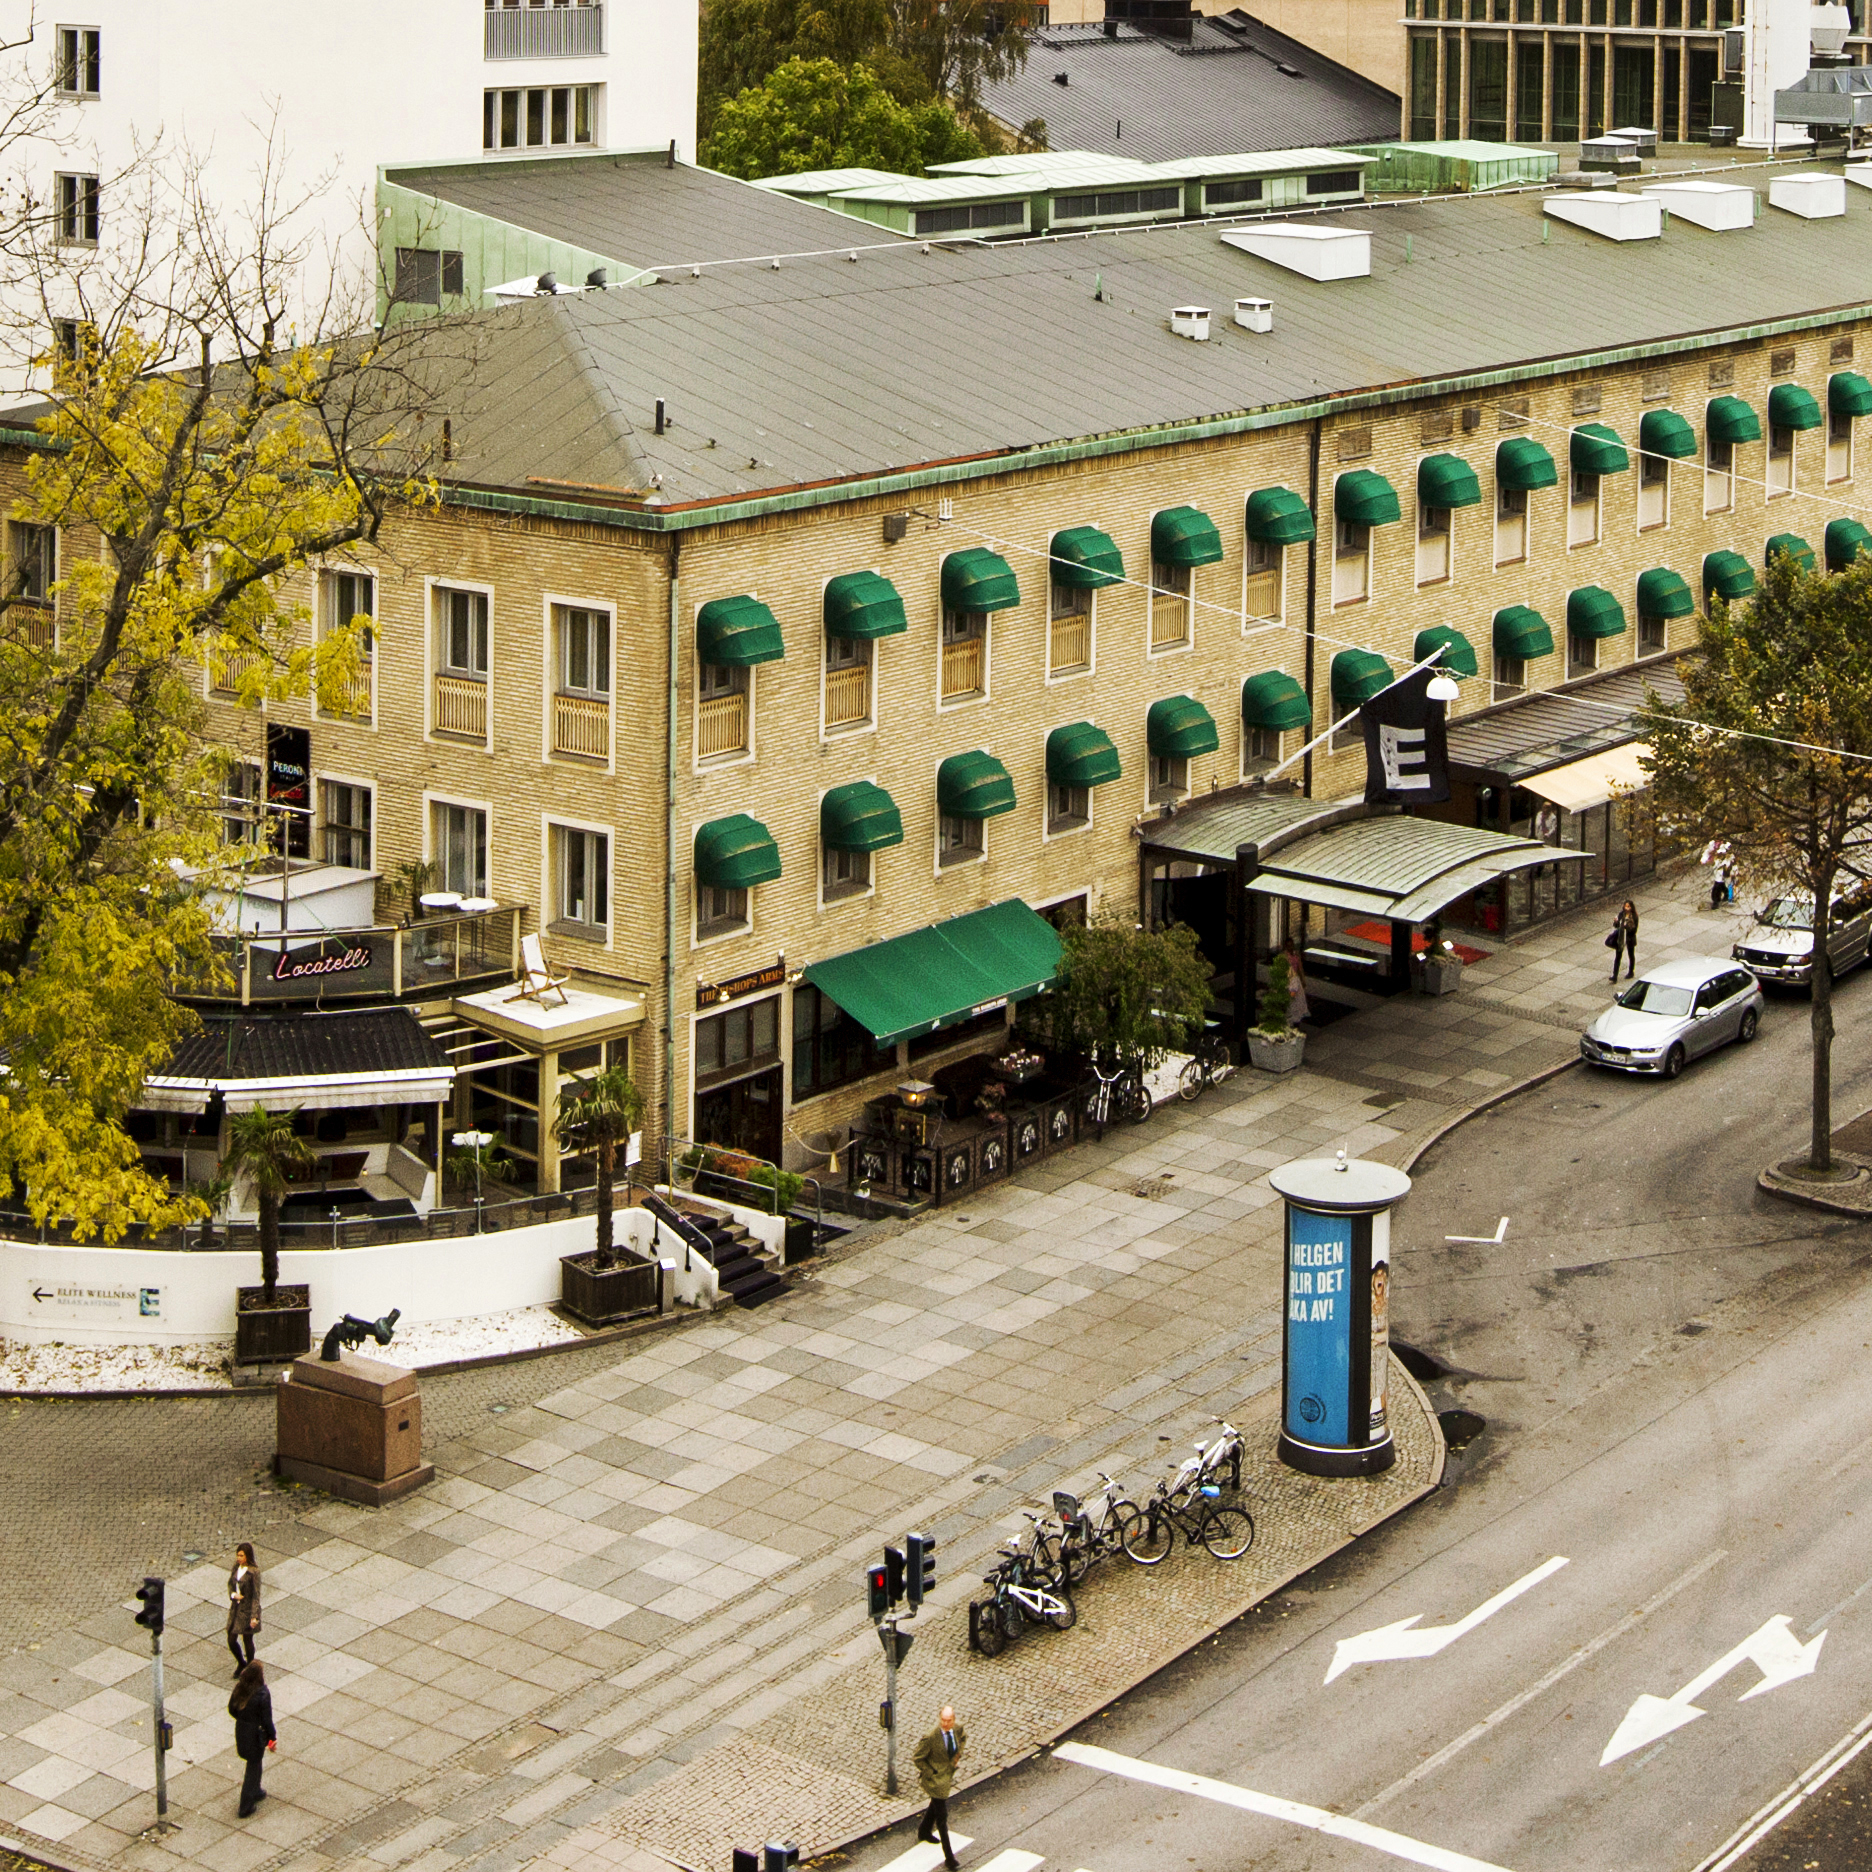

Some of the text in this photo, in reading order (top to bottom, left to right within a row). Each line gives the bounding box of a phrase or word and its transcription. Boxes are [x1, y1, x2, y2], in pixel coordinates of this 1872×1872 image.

[273, 760, 303, 776] PERONI
[1380, 723, 1431, 789] E
[275, 947, 370, 980] Locatelli
[759, 968, 784, 984] ARMS
[1294, 1241, 1343, 1266] HELGEN
[1317, 1268, 1345, 1294] DET
[57, 1288, 137, 1300] ELITE WELLNESS
[139, 1287, 161, 1317] E
[1310, 1299, 1334, 1322] AV!
